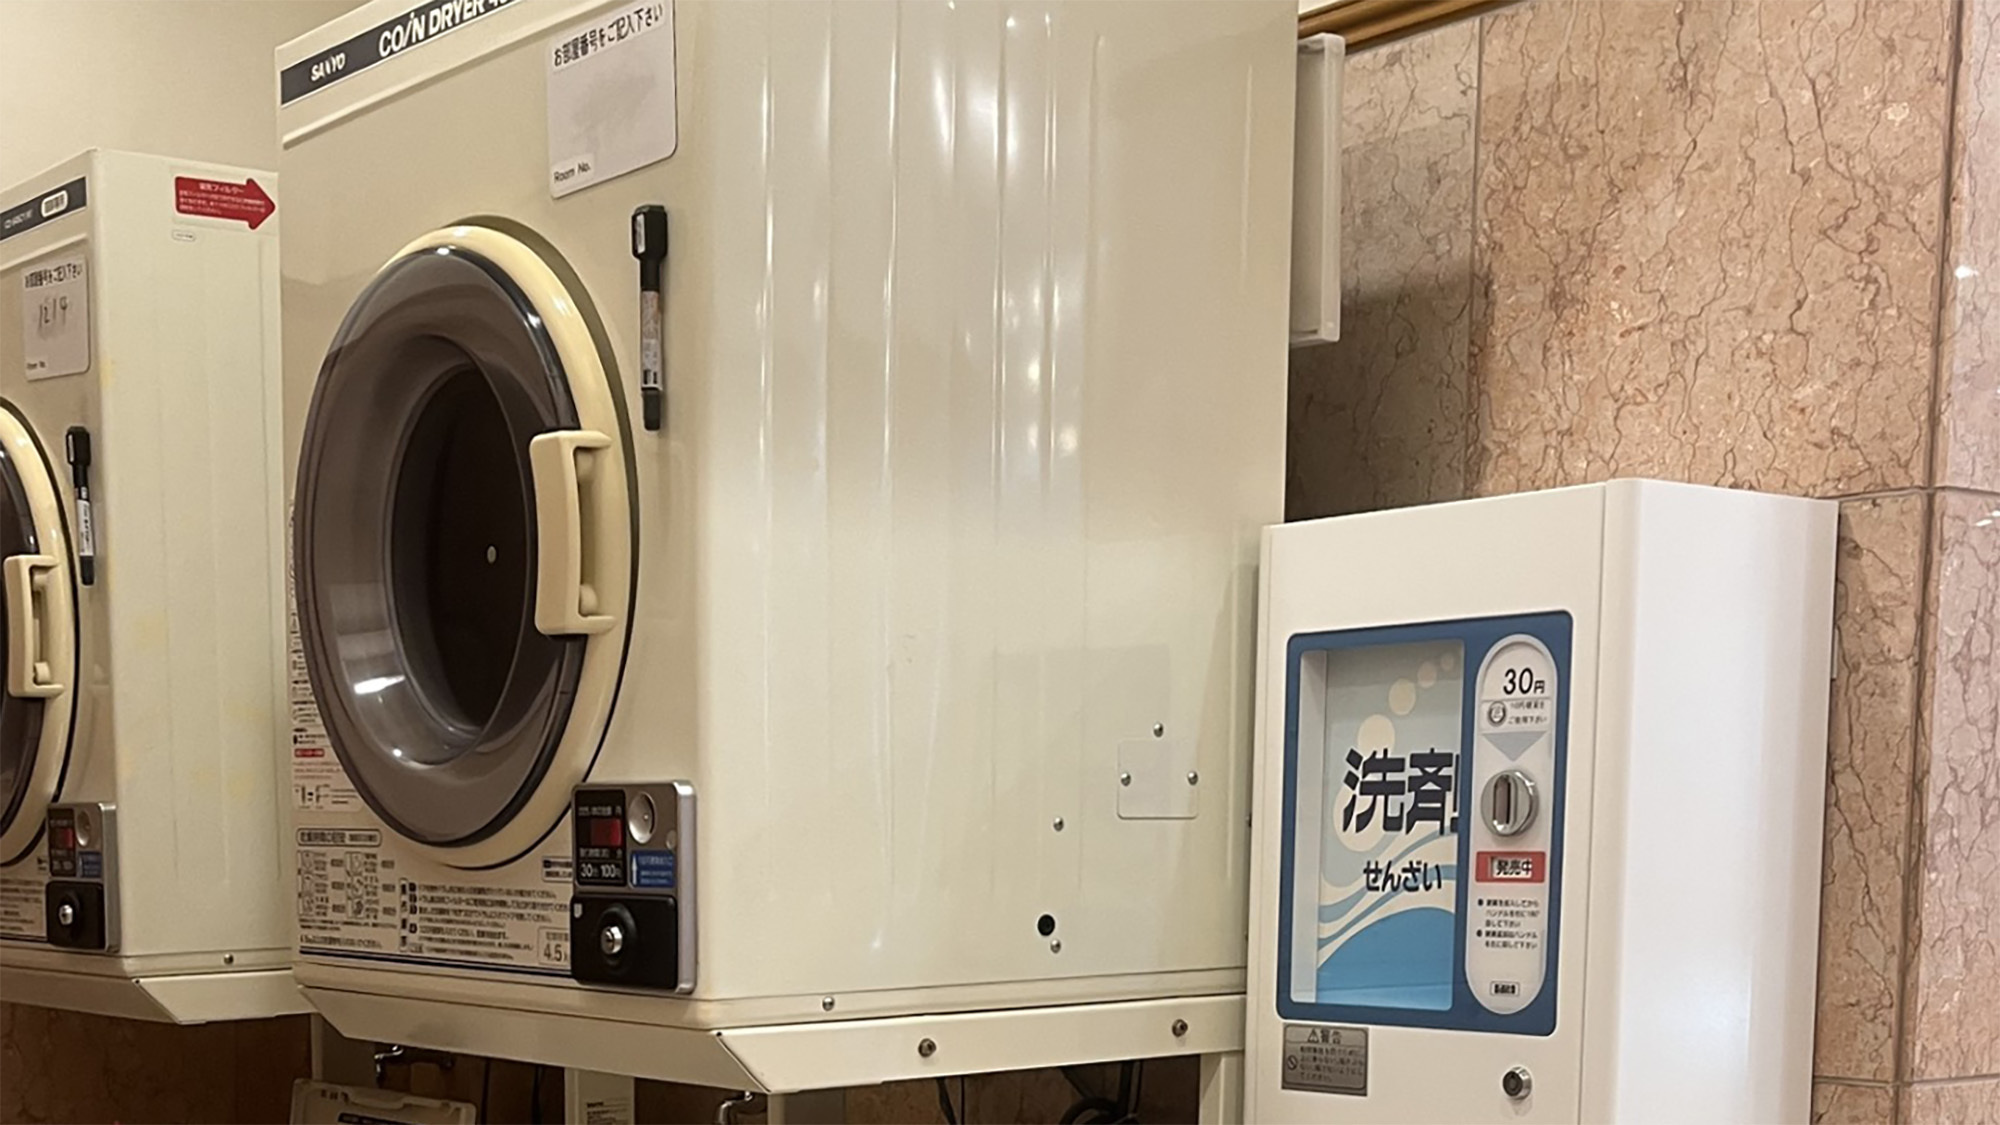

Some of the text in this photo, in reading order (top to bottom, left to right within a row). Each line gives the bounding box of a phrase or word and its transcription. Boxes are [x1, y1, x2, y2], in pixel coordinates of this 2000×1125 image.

[428, 0, 485, 36] DRYER
[553, 3, 663, 67] お部屋番号をご記入下さい
[310, 52, 346, 81] SANYO
[553, 168, 575, 184] Room
[1503, 667, 1545, 695] 30円
[1363, 860, 1442, 892] せんざい
[1496, 858, 1532, 876] 発売中
